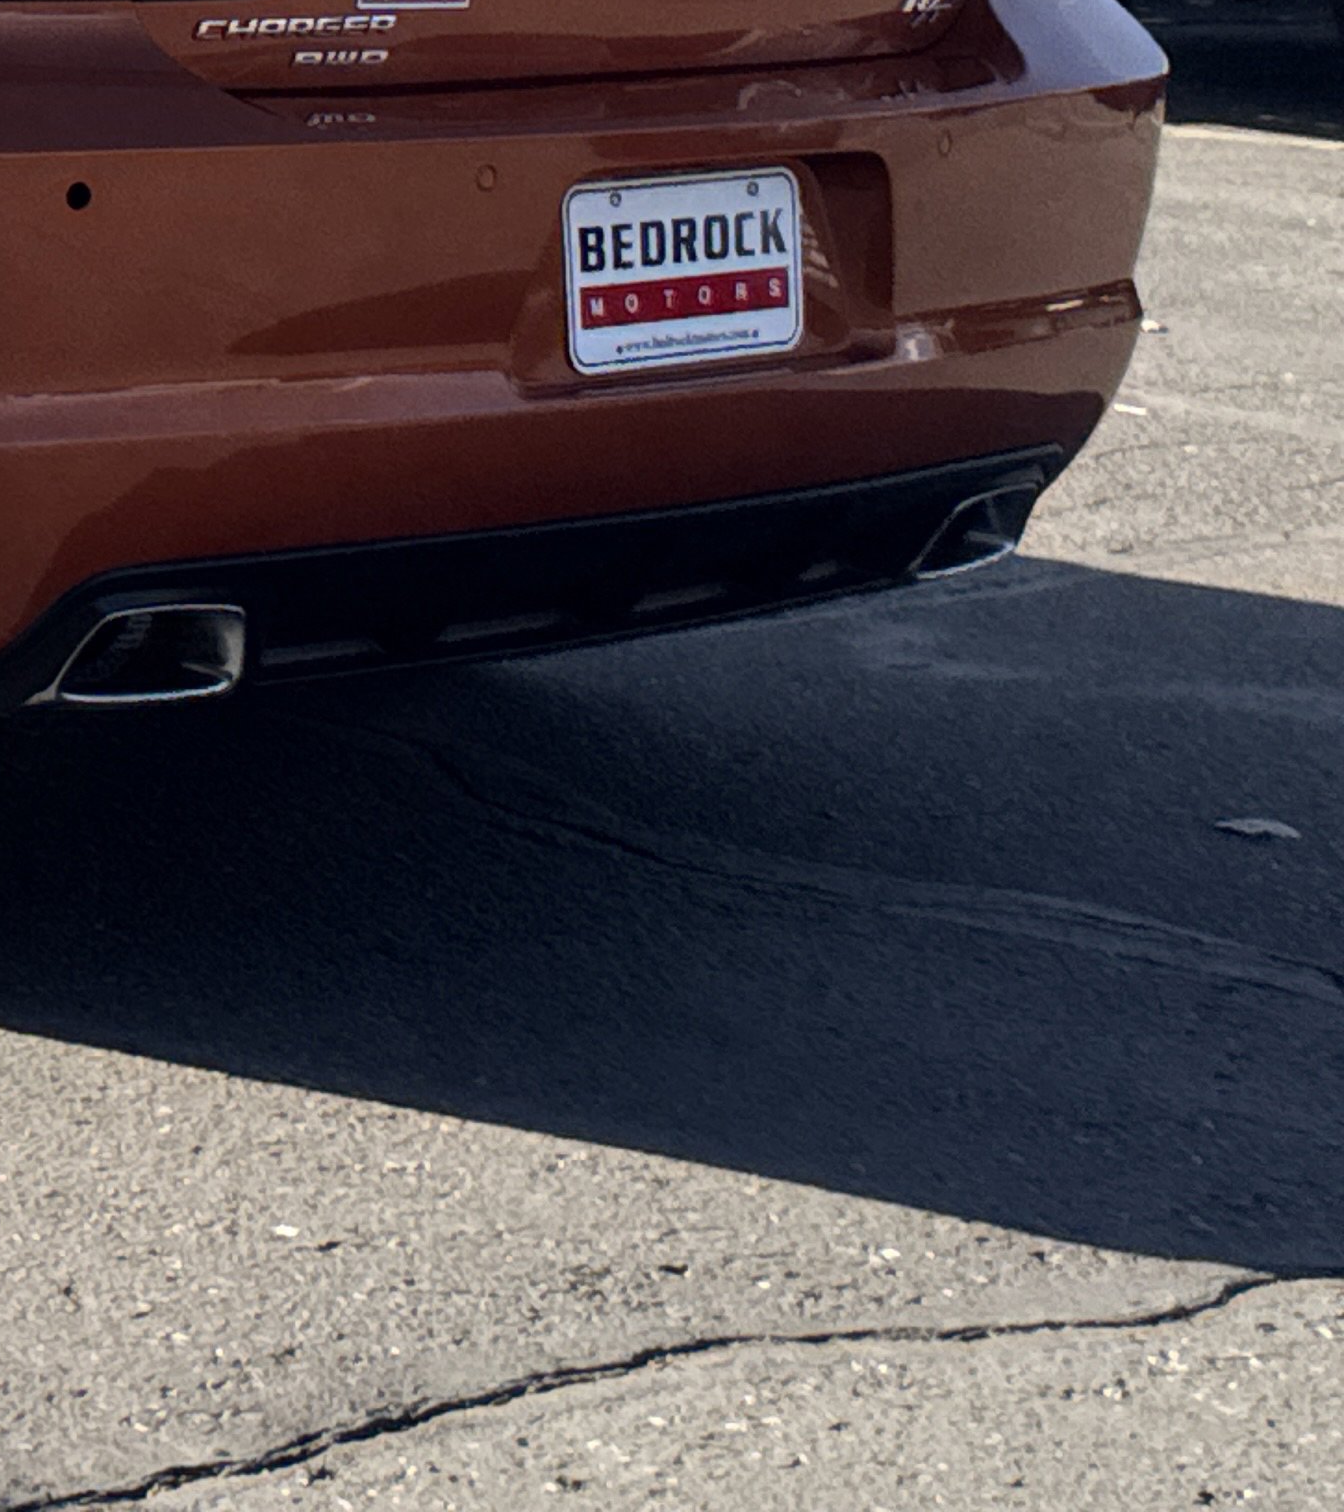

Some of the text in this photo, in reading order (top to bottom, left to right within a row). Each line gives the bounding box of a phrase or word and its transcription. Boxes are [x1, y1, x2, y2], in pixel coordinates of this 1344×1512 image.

[193, 14, 397, 39] CHARGER
[292, 49, 389, 67] AWD
[578, 207, 788, 273] BEDROCK
[588, 277, 783, 317] MOTORS
